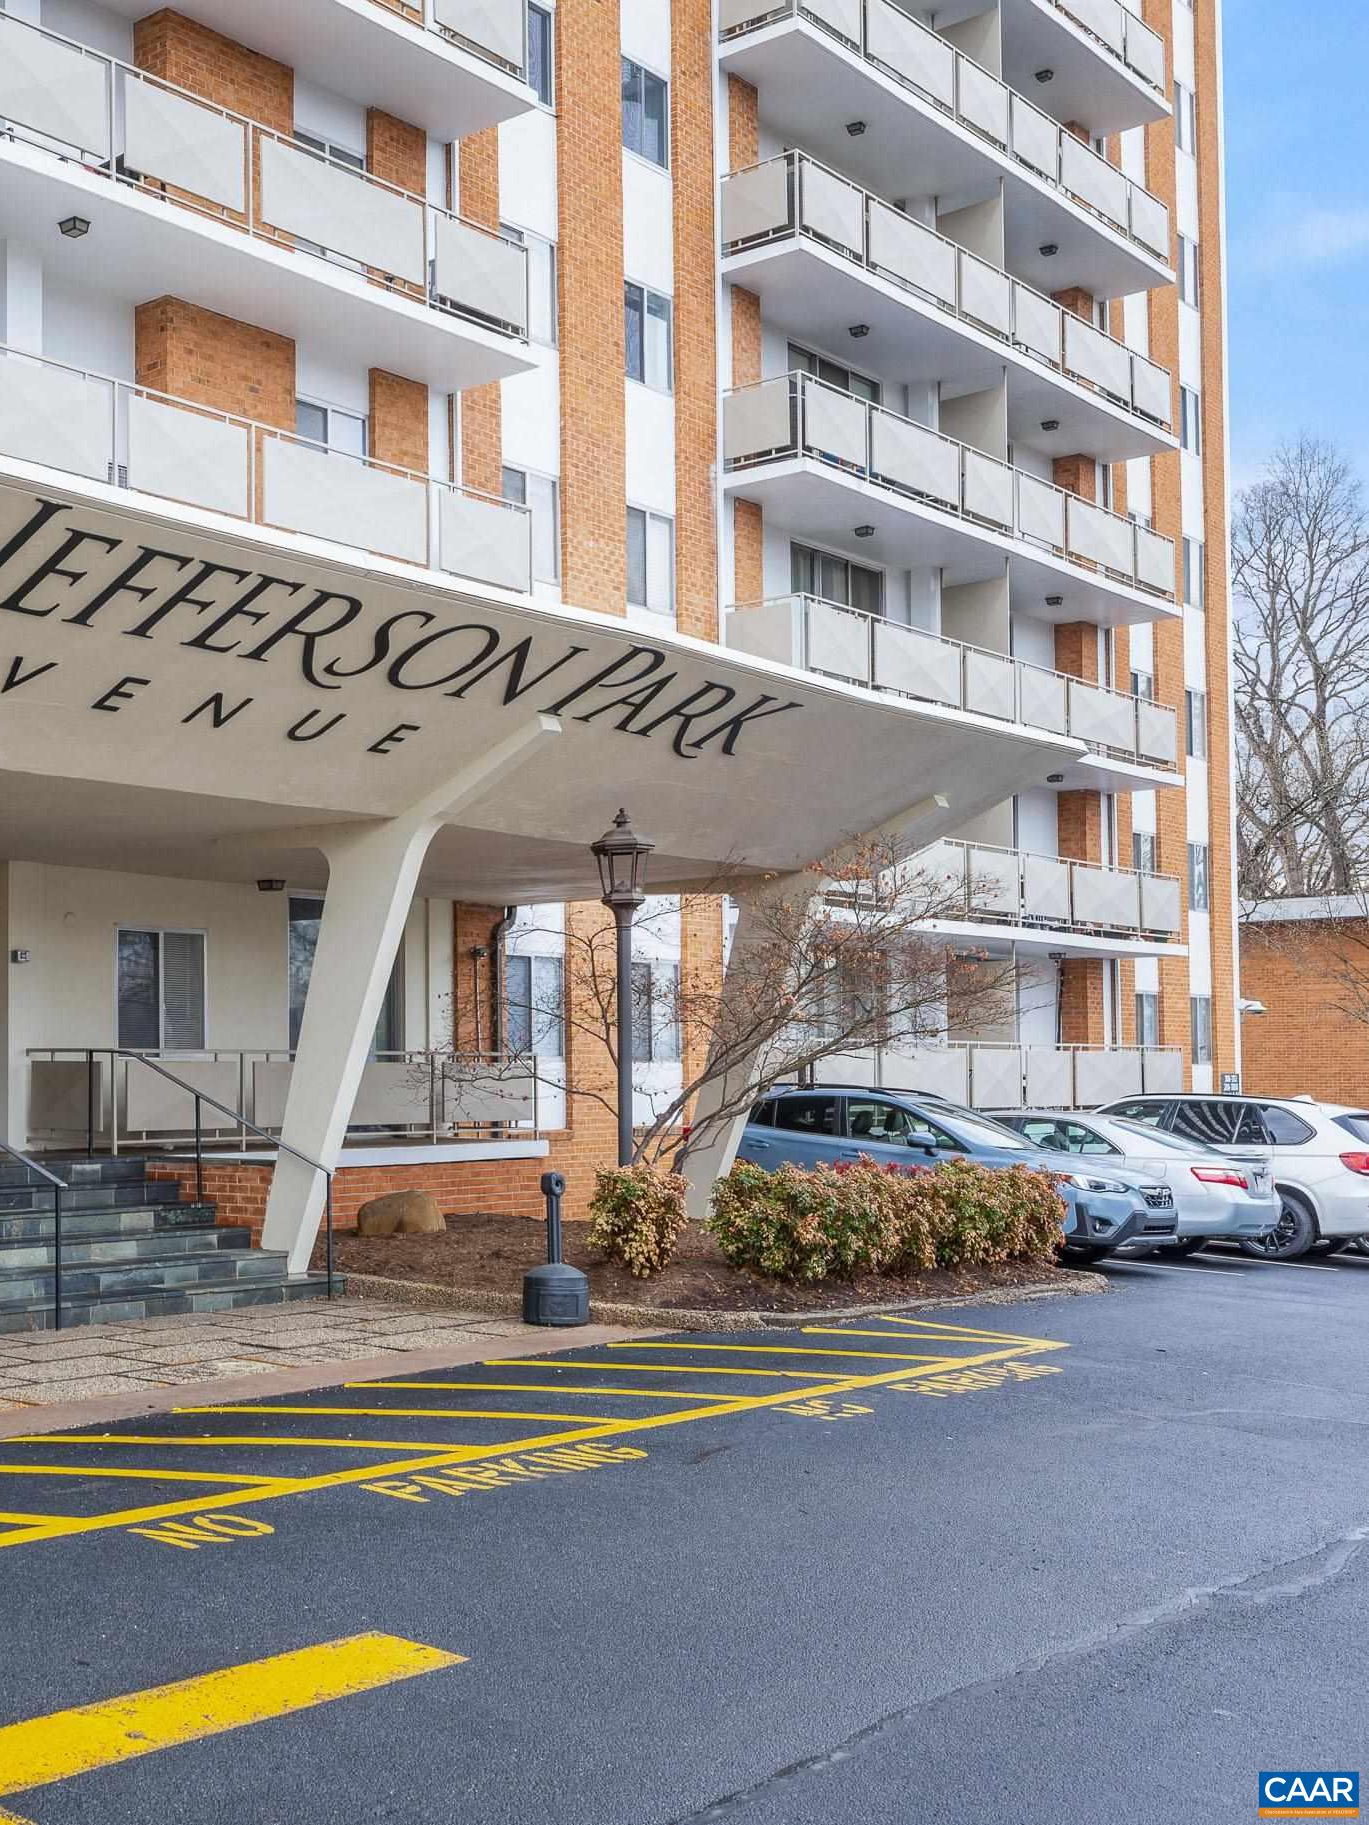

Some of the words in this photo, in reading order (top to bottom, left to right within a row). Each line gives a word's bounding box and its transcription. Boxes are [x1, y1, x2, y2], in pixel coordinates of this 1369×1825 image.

[538, 644, 804, 759] PARK
[127, 1514, 275, 1550] NO
[359, 1443, 648, 1503] PARKING
